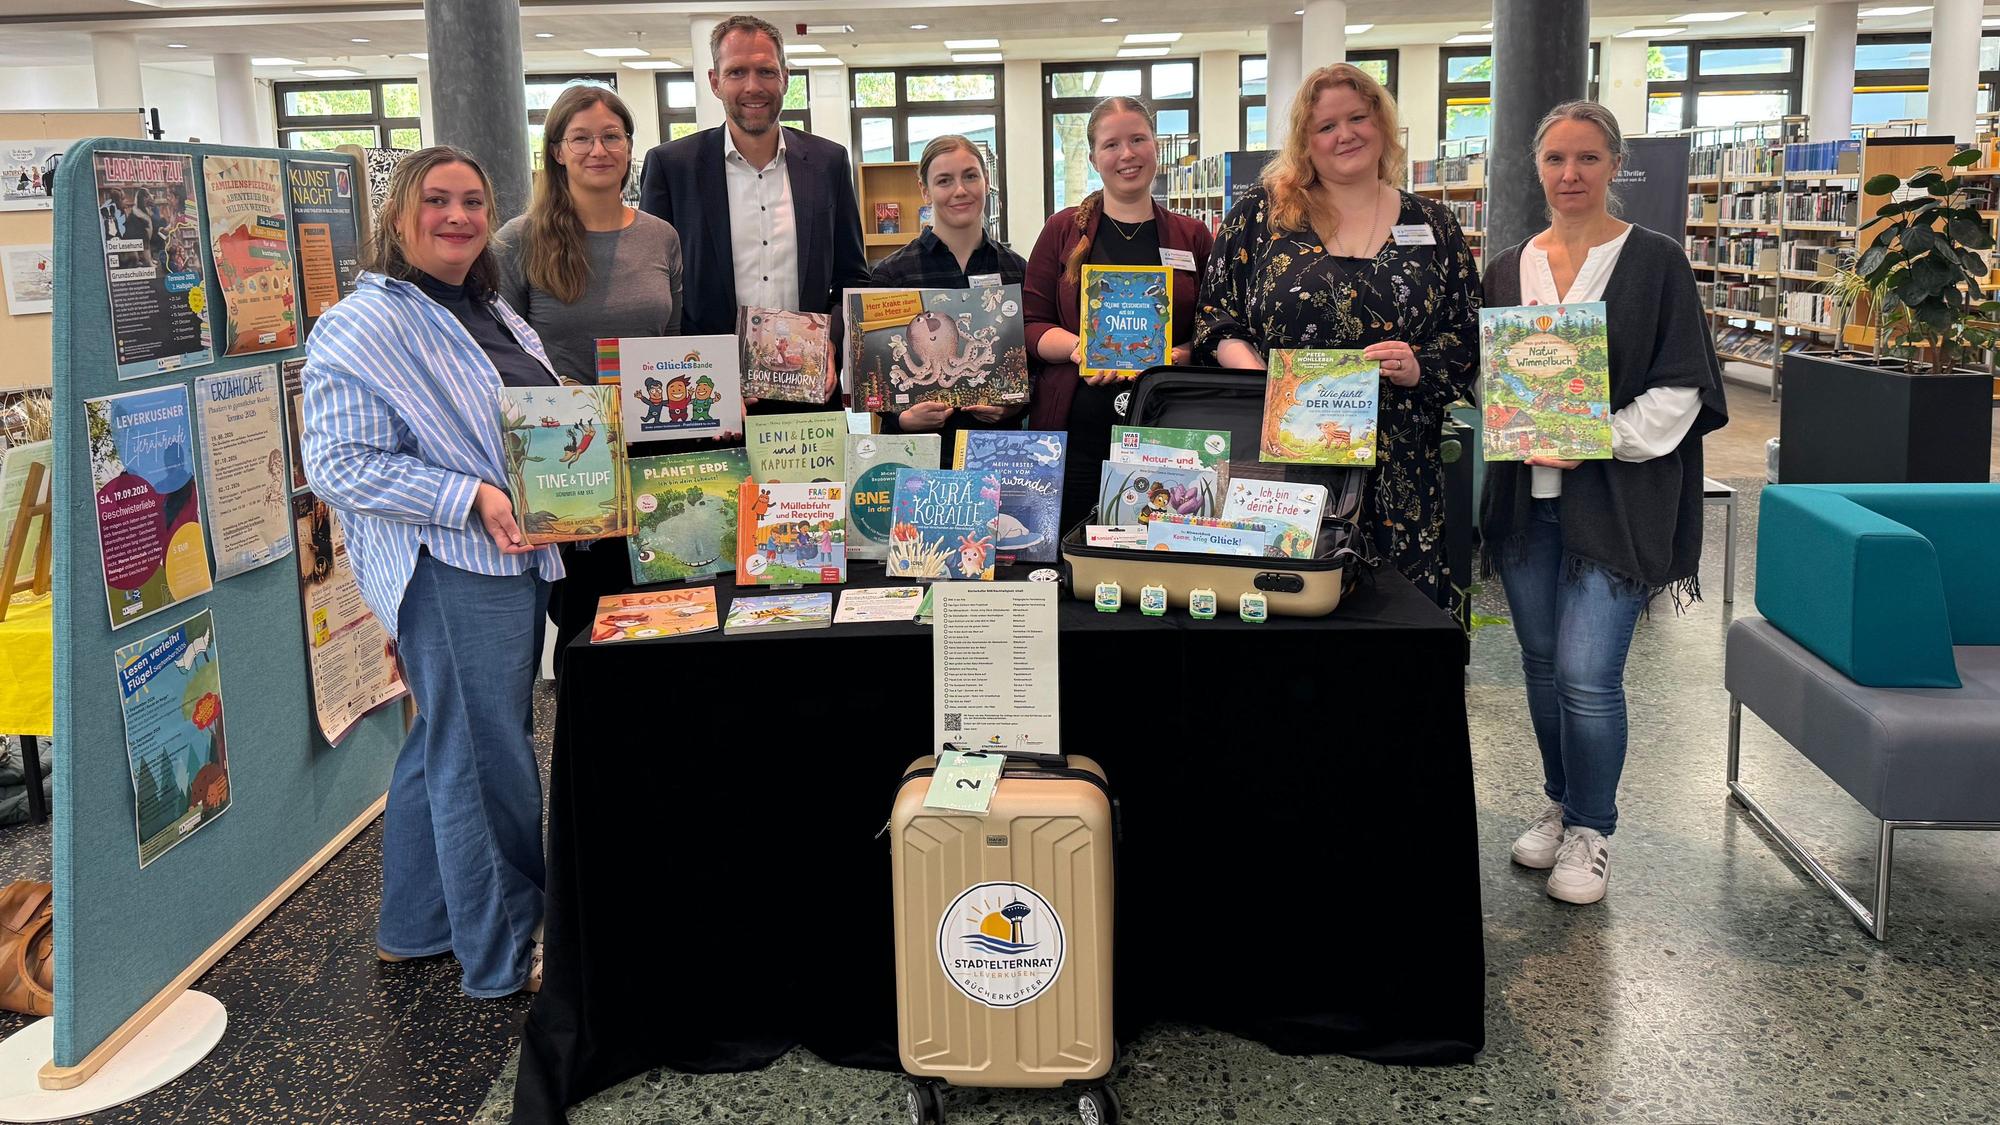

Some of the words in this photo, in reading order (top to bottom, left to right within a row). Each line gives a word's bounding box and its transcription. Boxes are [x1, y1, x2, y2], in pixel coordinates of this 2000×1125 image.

[104, 157, 136, 183] LARA
[136, 156, 164, 182] HÖRT
[165, 160, 183, 182] ZU!
[289, 168, 330, 188] KUNST
[211, 180, 276, 192] FAMILIENSPIELETAG
[226, 192, 262, 203] ABENTEUER
[292, 187, 333, 205] NACHT
[226, 203, 249, 214] WILDEN
[249, 203, 272, 213] WESTEN
[108, 241, 118, 251] Der
[118, 241, 144, 251] Lesehund
[110, 257, 118, 267] für
[111, 268, 156, 281] Grundschulkinder
[882, 300, 901, 309] Krake
[884, 308, 902, 316] Meer
[1105, 315, 1148, 332] NATUR
[1529, 346, 1558, 356] Natur
[643, 361, 654, 371] Die
[1516, 356, 1572, 367] Wimmelbuch
[748, 370, 771, 382] EGON
[773, 371, 816, 385] EICHHORN
[211, 371, 264, 402] ERZÄHLCAFÉ
[1319, 390, 1338, 398] Wie
[1338, 390, 1363, 402] fühlt
[1306, 400, 1329, 408] DER
[1332, 400, 1373, 408] WALD?
[116, 404, 184, 430] LEVERKUSENER
[760, 431, 788, 444] LENI
[790, 430, 798, 440] &
[800, 427, 834, 441] LEON
[124, 424, 186, 467] Literaturcafé
[773, 444, 796, 455] und
[801, 442, 818, 455] DIE
[761, 457, 807, 471] KAPUTTE
[810, 455, 835, 469] LOK
[1142, 455, 1173, 463] Natur-
[1176, 457, 1194, 465] und
[643, 465, 695, 480] PLANET
[699, 461, 729, 474] ERDE
[536, 472, 569, 490] TINE
[569, 475, 577, 485] &
[577, 470, 611, 488] TUPF
[100, 495, 113, 505] SA,
[113, 485, 149, 502] 19.09.2026
[808, 488, 827, 497] FRAG
[855, 490, 890, 505] BNE
[928, 479, 973, 505] KIRA
[1260, 486, 1272, 498] Ich
[1274, 490, 1290, 500] bin
[102, 499, 156, 521] Geschwisterliebe
[780, 502, 831, 510] Müllabfuhr
[876, 505, 891, 513] der
[910, 495, 985, 527] KORALLE
[1247, 501, 1273, 513] deine
[1276, 502, 1299, 516] Erde
[791, 510, 835, 521] Recycling
[1193, 535, 1208, 543] bring
[1210, 534, 1242, 546] Glück!
[621, 592, 694, 607] EGON
[123, 657, 149, 681] Lesen
[149, 631, 181, 661] verleiht
[127, 664, 154, 692] Flügel
[956, 778, 981, 790] 2
[954, 958, 1053, 970] STADTELTERNRAT
[974, 970, 1036, 979] LEVERKUSEN
[964, 979, 1043, 1000] BÜCHERKOFFER
